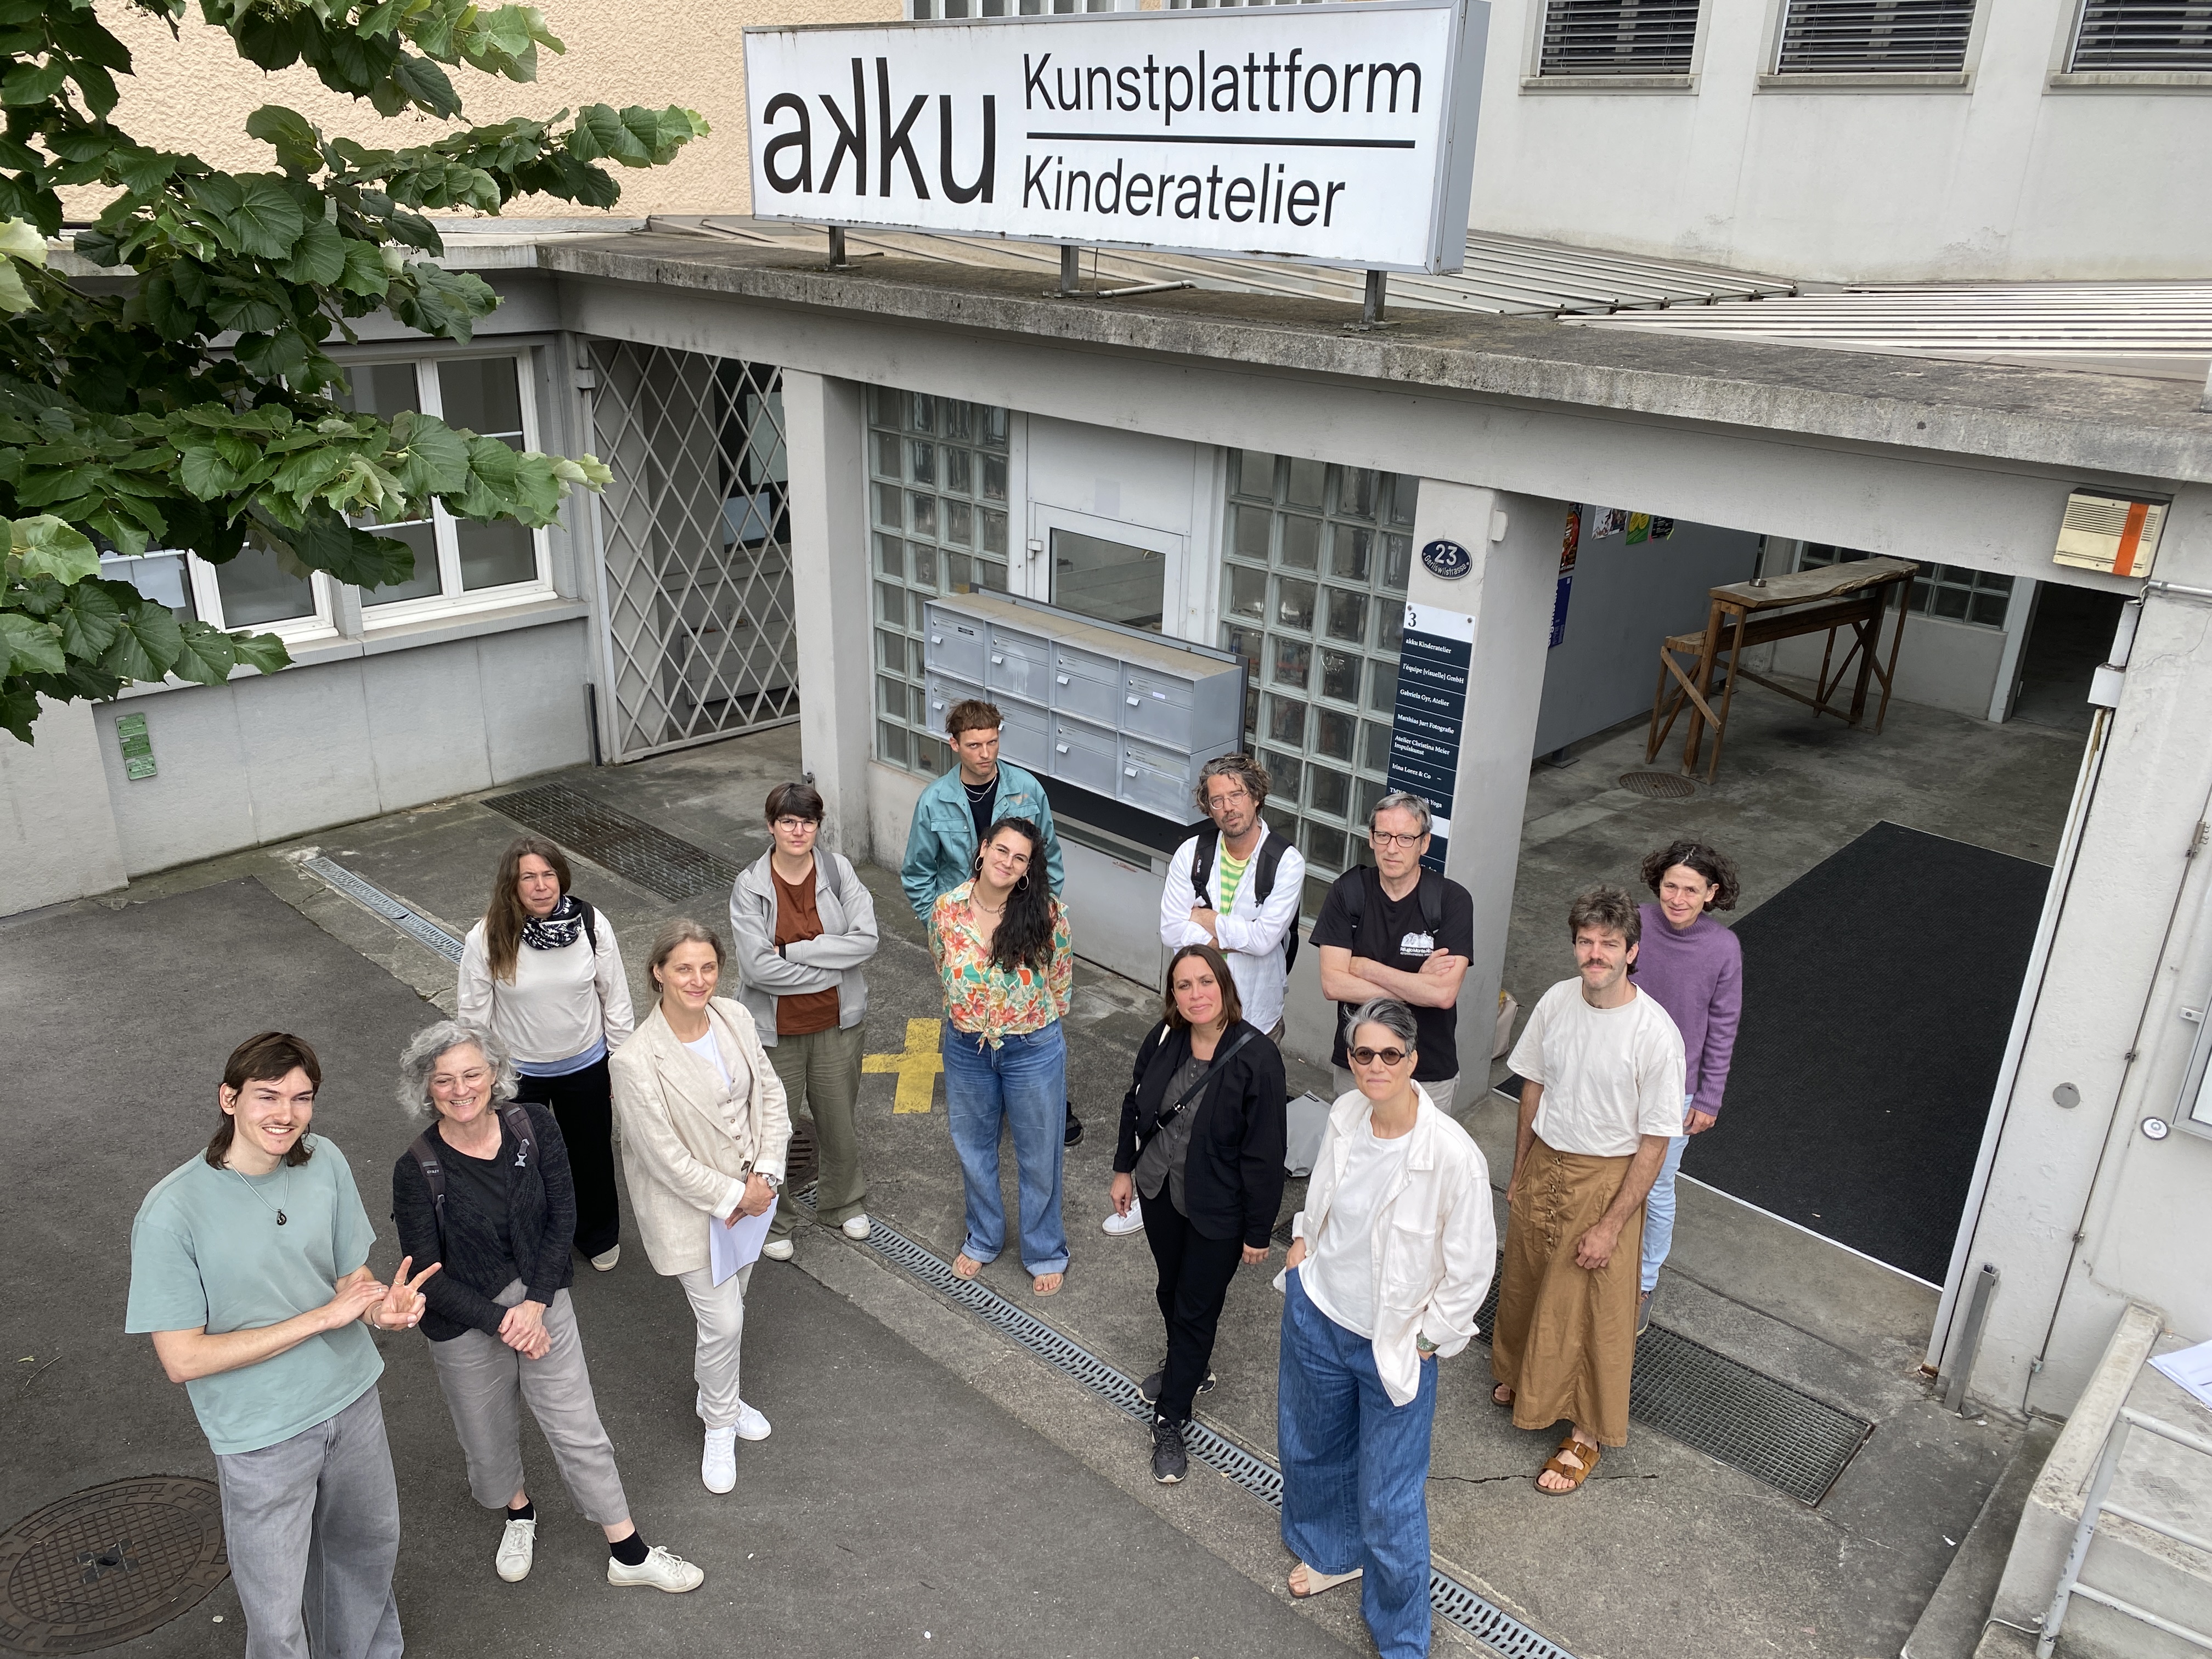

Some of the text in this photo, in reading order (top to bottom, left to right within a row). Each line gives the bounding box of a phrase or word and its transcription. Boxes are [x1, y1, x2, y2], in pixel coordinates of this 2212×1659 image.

[1023, 47, 1422, 126] Kunstplattform
[763, 57, 996, 205] akku
[1023, 155, 1346, 227] Kinderatelier
[1435, 543, 1458, 566] 23
[1424, 555, 1467, 575] Gerliswilstrasse
[1408, 612, 1417, 627] 3
[1419, 641, 1452, 654] Kinderatelier
[1446, 674, 1464, 684] GmbH
[1400, 689, 1450, 707] Gabriela Gyr, Atelier
[1397, 714, 1418, 724] Matthias
[1429, 722, 1454, 734] Fotografie
[1394, 742, 1424, 755] Impulskunst
[1395, 735, 1450, 755] Atelier Christina Meier
[1392, 763, 1404, 771] Irina
[1404, 766, 1418, 775] Lorez
[1430, 799, 1442, 808] Yoga
